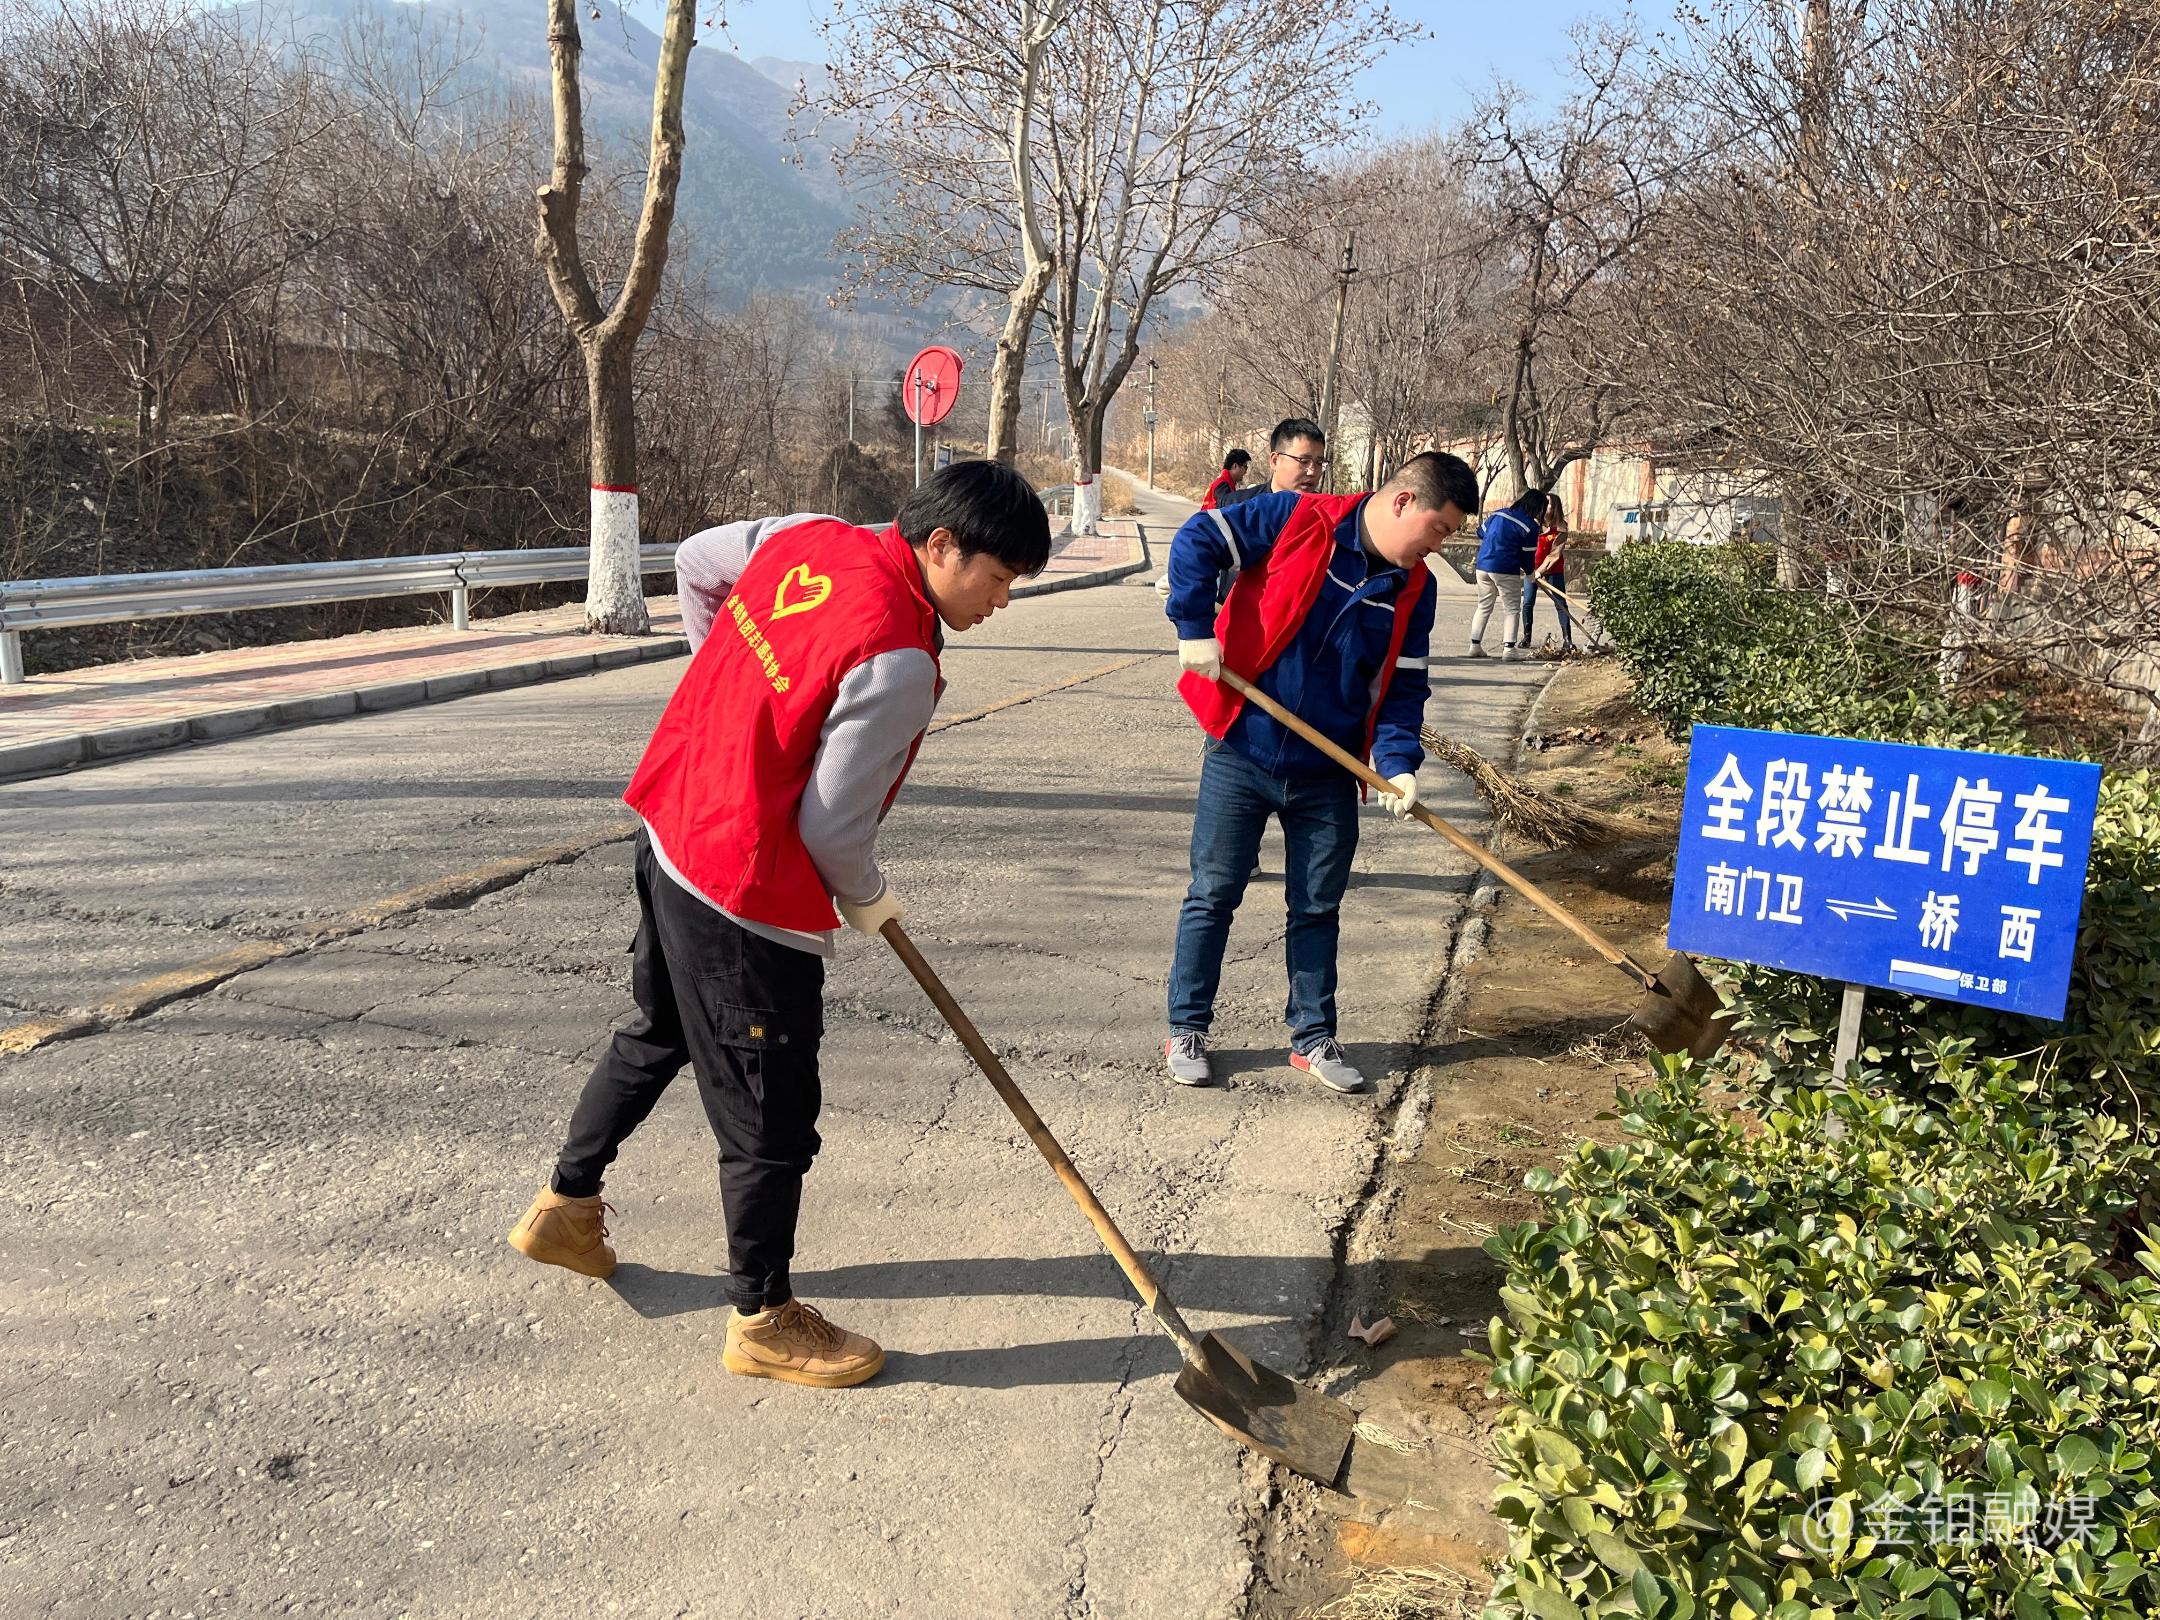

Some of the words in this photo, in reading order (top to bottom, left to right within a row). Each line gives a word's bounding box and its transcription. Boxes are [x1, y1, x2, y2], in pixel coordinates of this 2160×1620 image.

[1701, 752, 2070, 885] 全段禁止停车
[1703, 861, 1803, 925] 南门卫
[1959, 972, 2008, 995] 保卫部
